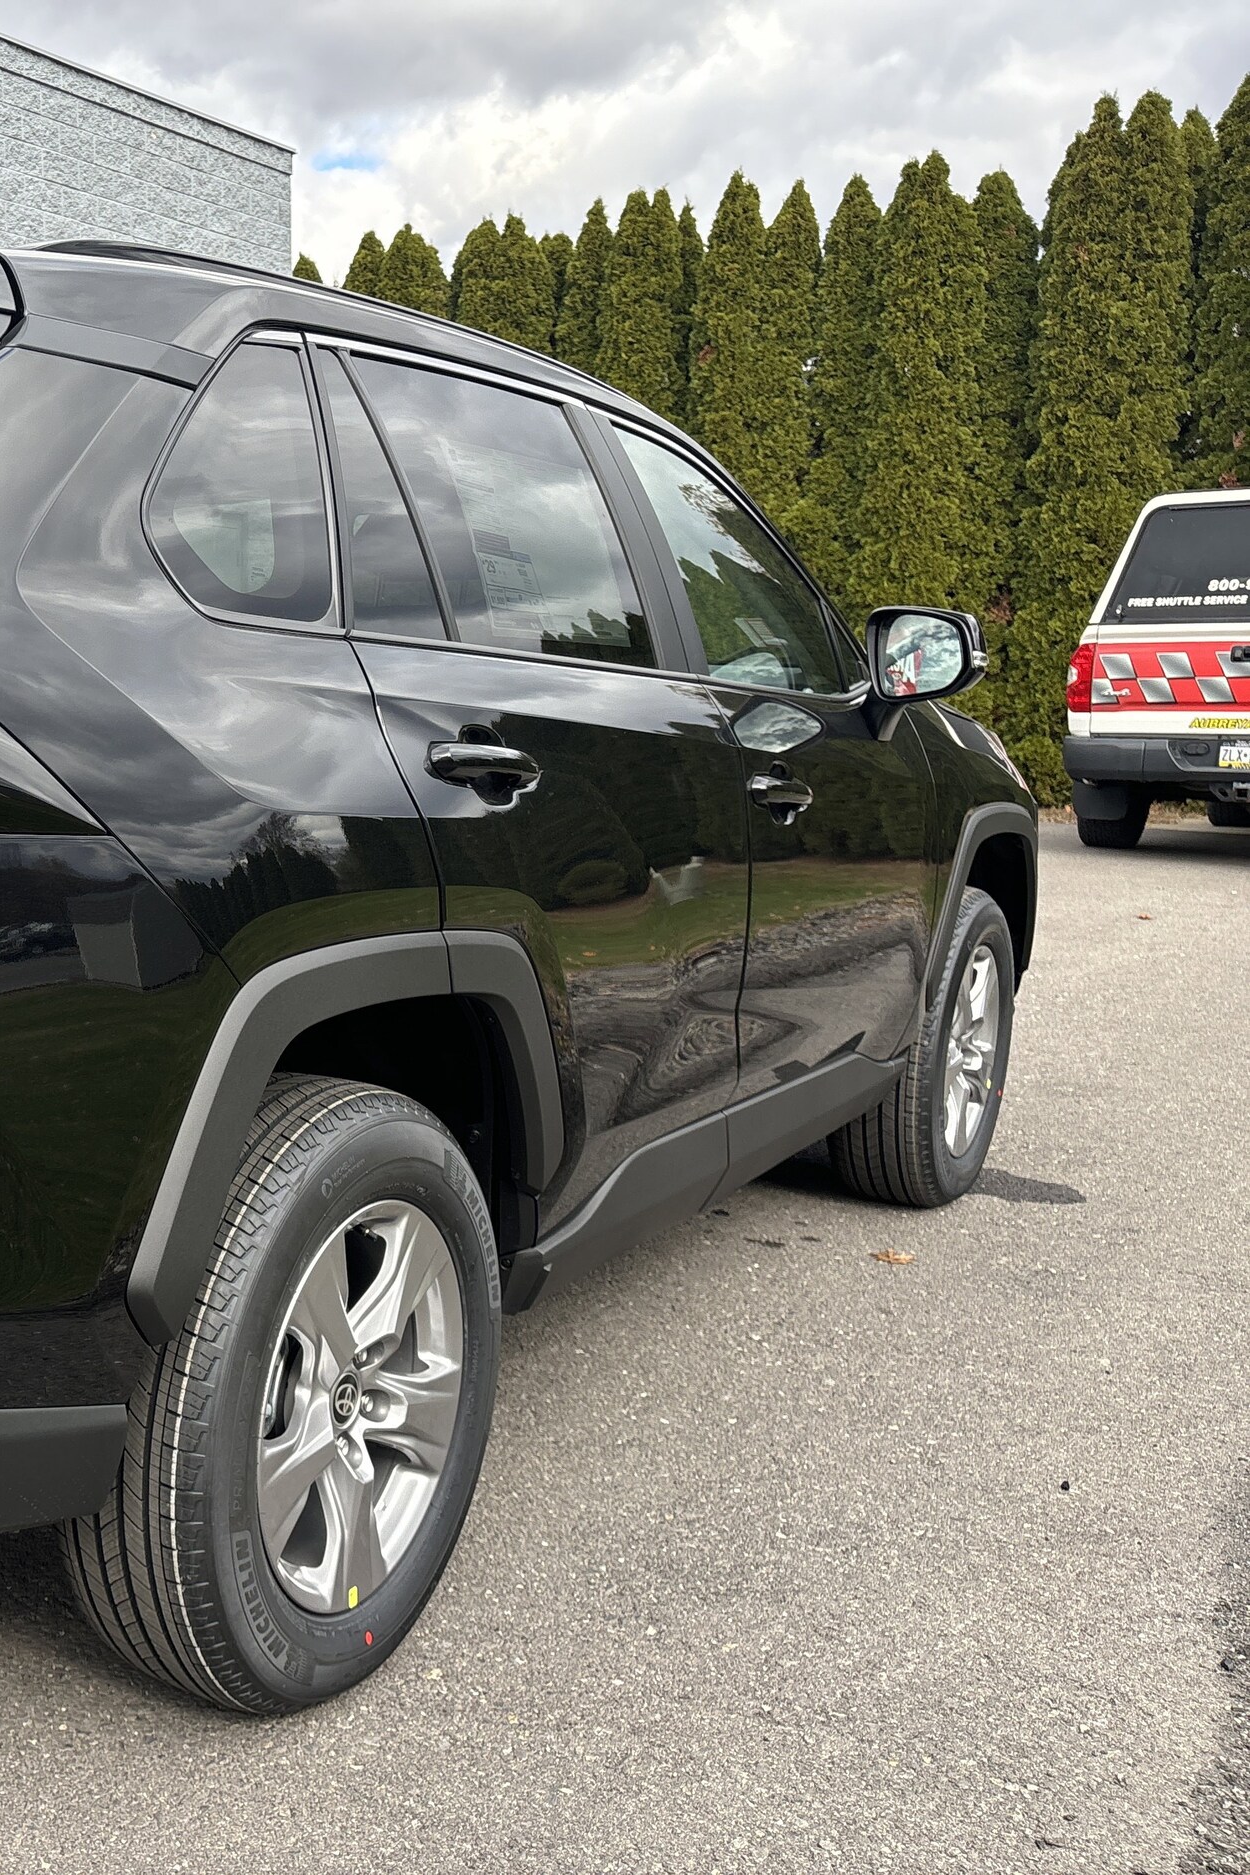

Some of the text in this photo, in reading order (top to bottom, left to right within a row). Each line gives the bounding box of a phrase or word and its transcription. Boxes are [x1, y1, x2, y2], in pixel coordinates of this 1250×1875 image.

[1128, 594, 1249, 608] FREE SHUTTLE SERVICE
[465, 1188, 501, 1303] MICHELIN
[235, 1538, 290, 1660] MICHELIN
